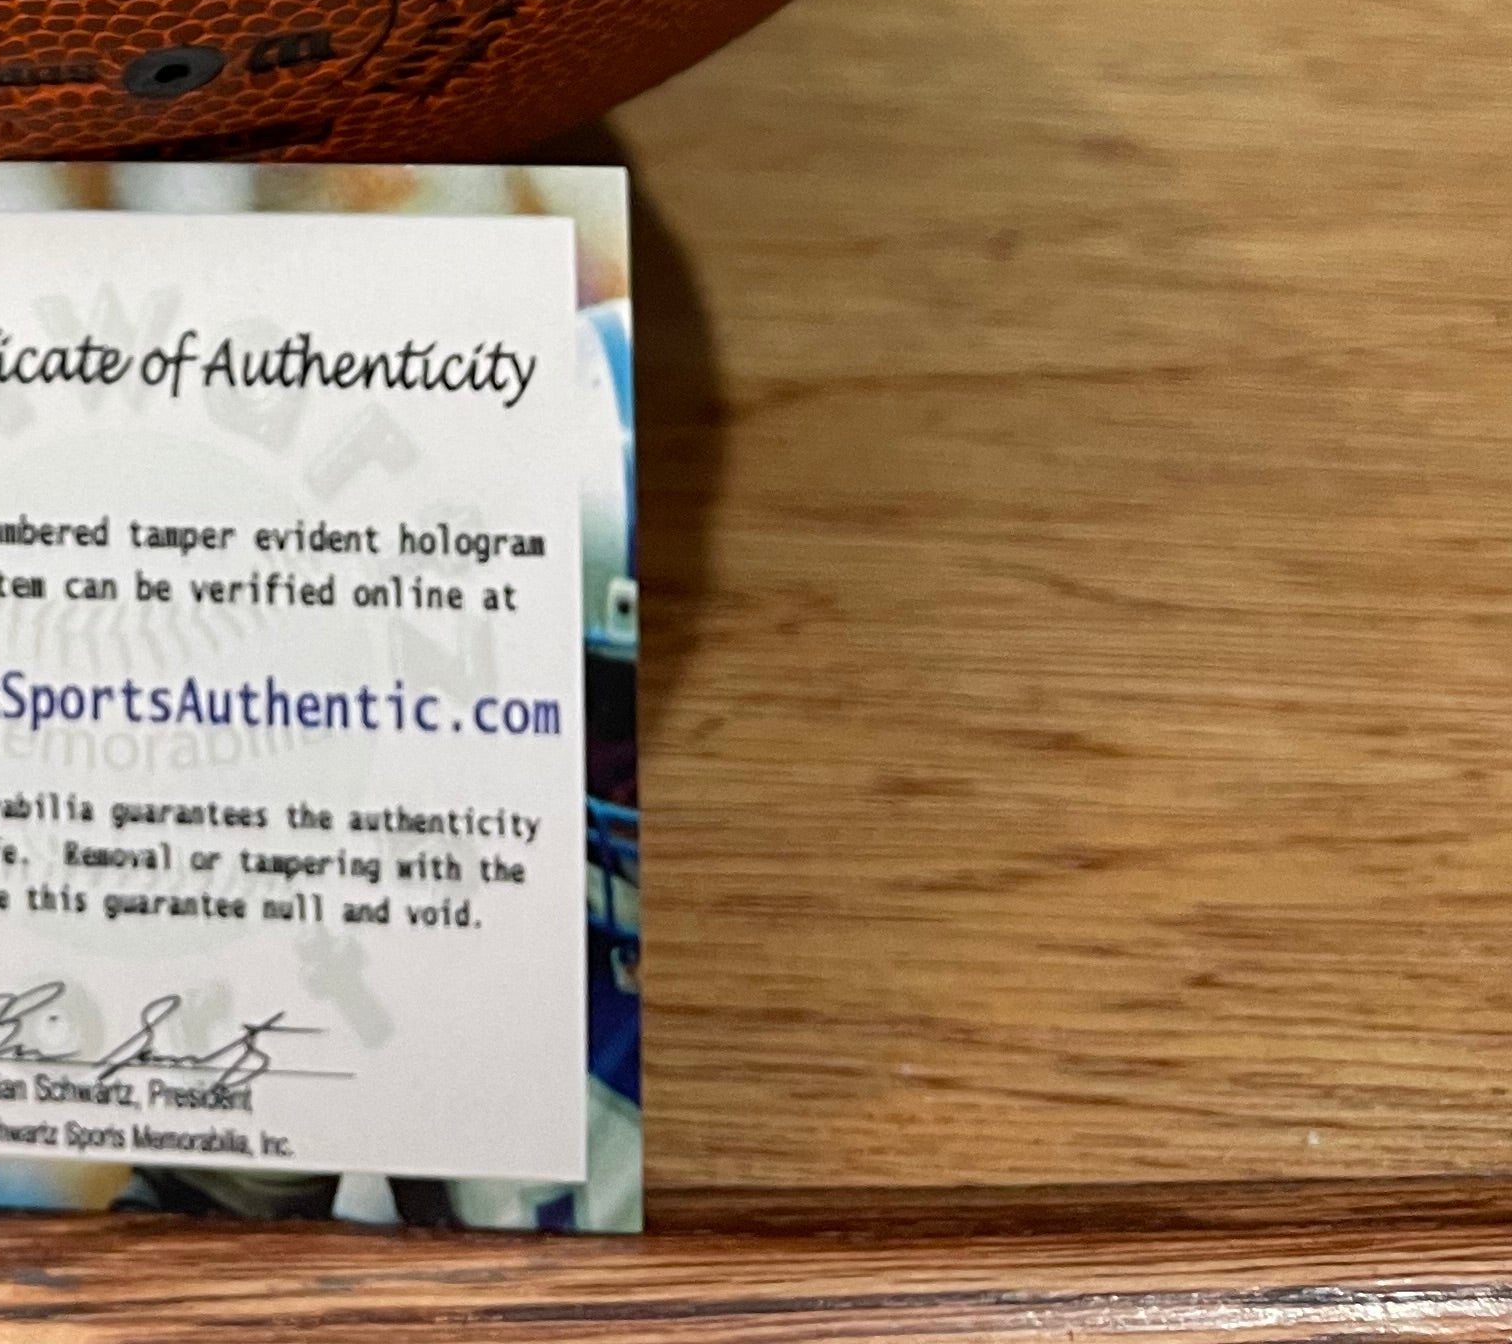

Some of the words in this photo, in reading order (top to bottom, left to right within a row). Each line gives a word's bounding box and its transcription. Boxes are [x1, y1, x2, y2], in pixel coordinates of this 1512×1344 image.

[140, 330, 199, 397] of
[202, 332, 538, 408] Authenticity
[129, 520, 237, 556] tamper
[254, 520, 381, 554] evident
[399, 523, 546, 564] hologram
[65, 576, 118, 601] can
[136, 570, 172, 603] be
[191, 572, 336, 607] verified
[354, 576, 464, 611] online
[483, 582, 519, 612] at
[111, 800, 269, 829] guarantees
[287, 800, 334, 831] the
[348, 804, 541, 843] authenticity
[64, 839, 172, 871] Removal
[190, 849, 222, 872] or
[240, 848, 381, 884] tampering
[396, 852, 462, 883] with
[480, 853, 526, 884] the
[27, 882, 88, 913] this
[103, 890, 247, 919] guarantee
[262, 891, 324, 923] null
[342, 895, 390, 925] and
[404, 897, 483, 930] void.
[34, 1074, 141, 1110] Schwartz,
[147, 1078, 253, 1115] President
[64, 1119, 126, 1152] Sports
[260, 1130, 296, 1159] Inc.
